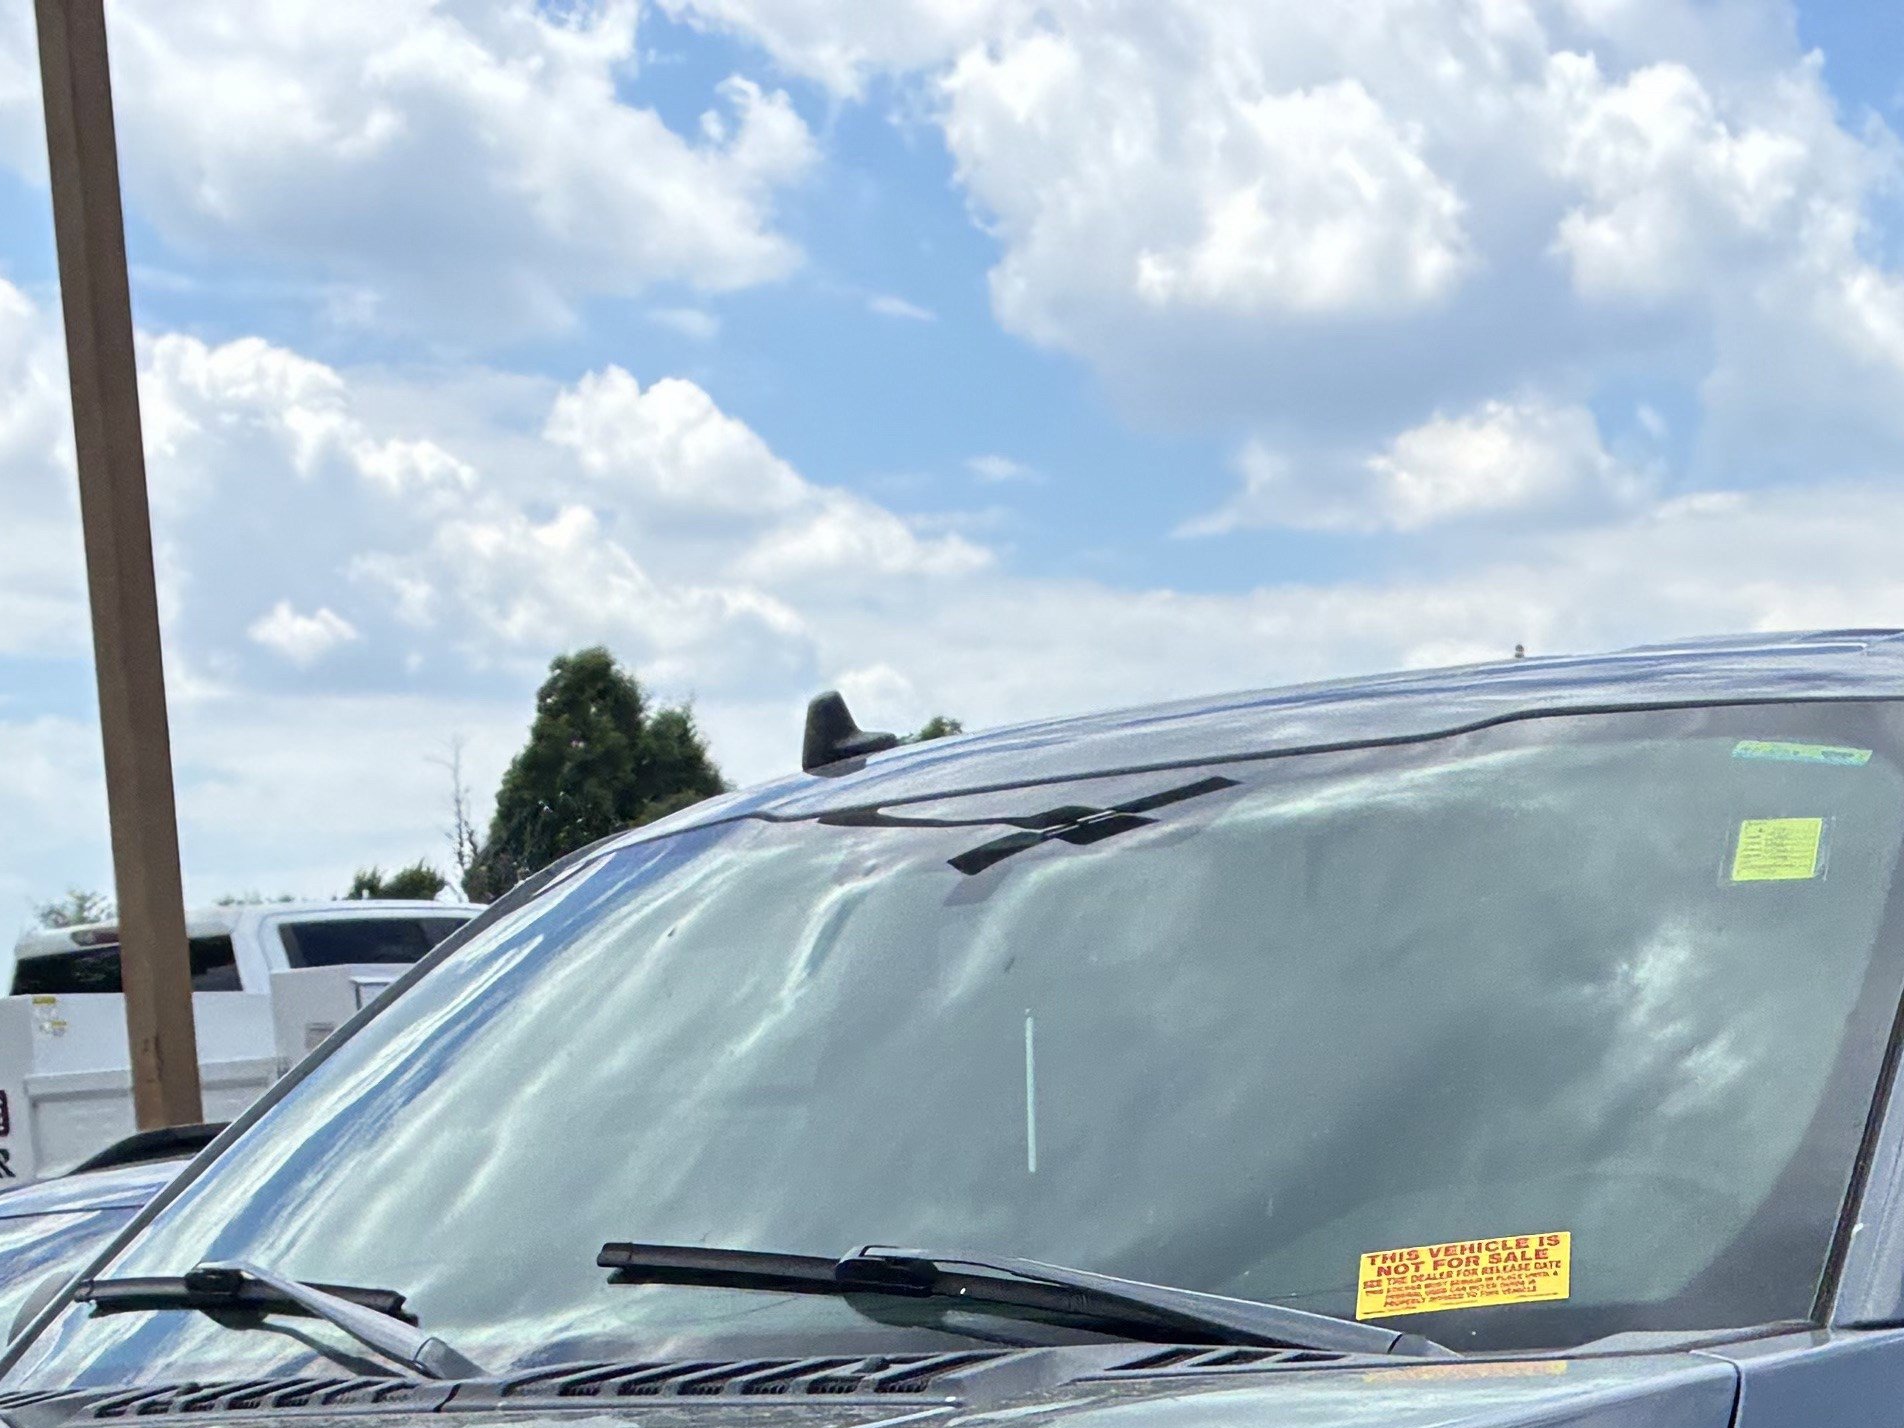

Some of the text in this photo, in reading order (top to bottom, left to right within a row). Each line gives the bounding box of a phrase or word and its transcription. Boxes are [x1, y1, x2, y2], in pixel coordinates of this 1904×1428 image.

[1365, 1235, 1560, 1265] THIS VEHICLE IS
[1377, 1248, 1548, 1277] NOT FOR SALE
[1411, 1270, 1453, 1283] DEALER
[1456, 1268, 1478, 1278] FOR
[1481, 1263, 1530, 1275] RELEASE
[1534, 1260, 1561, 1270] DATE
